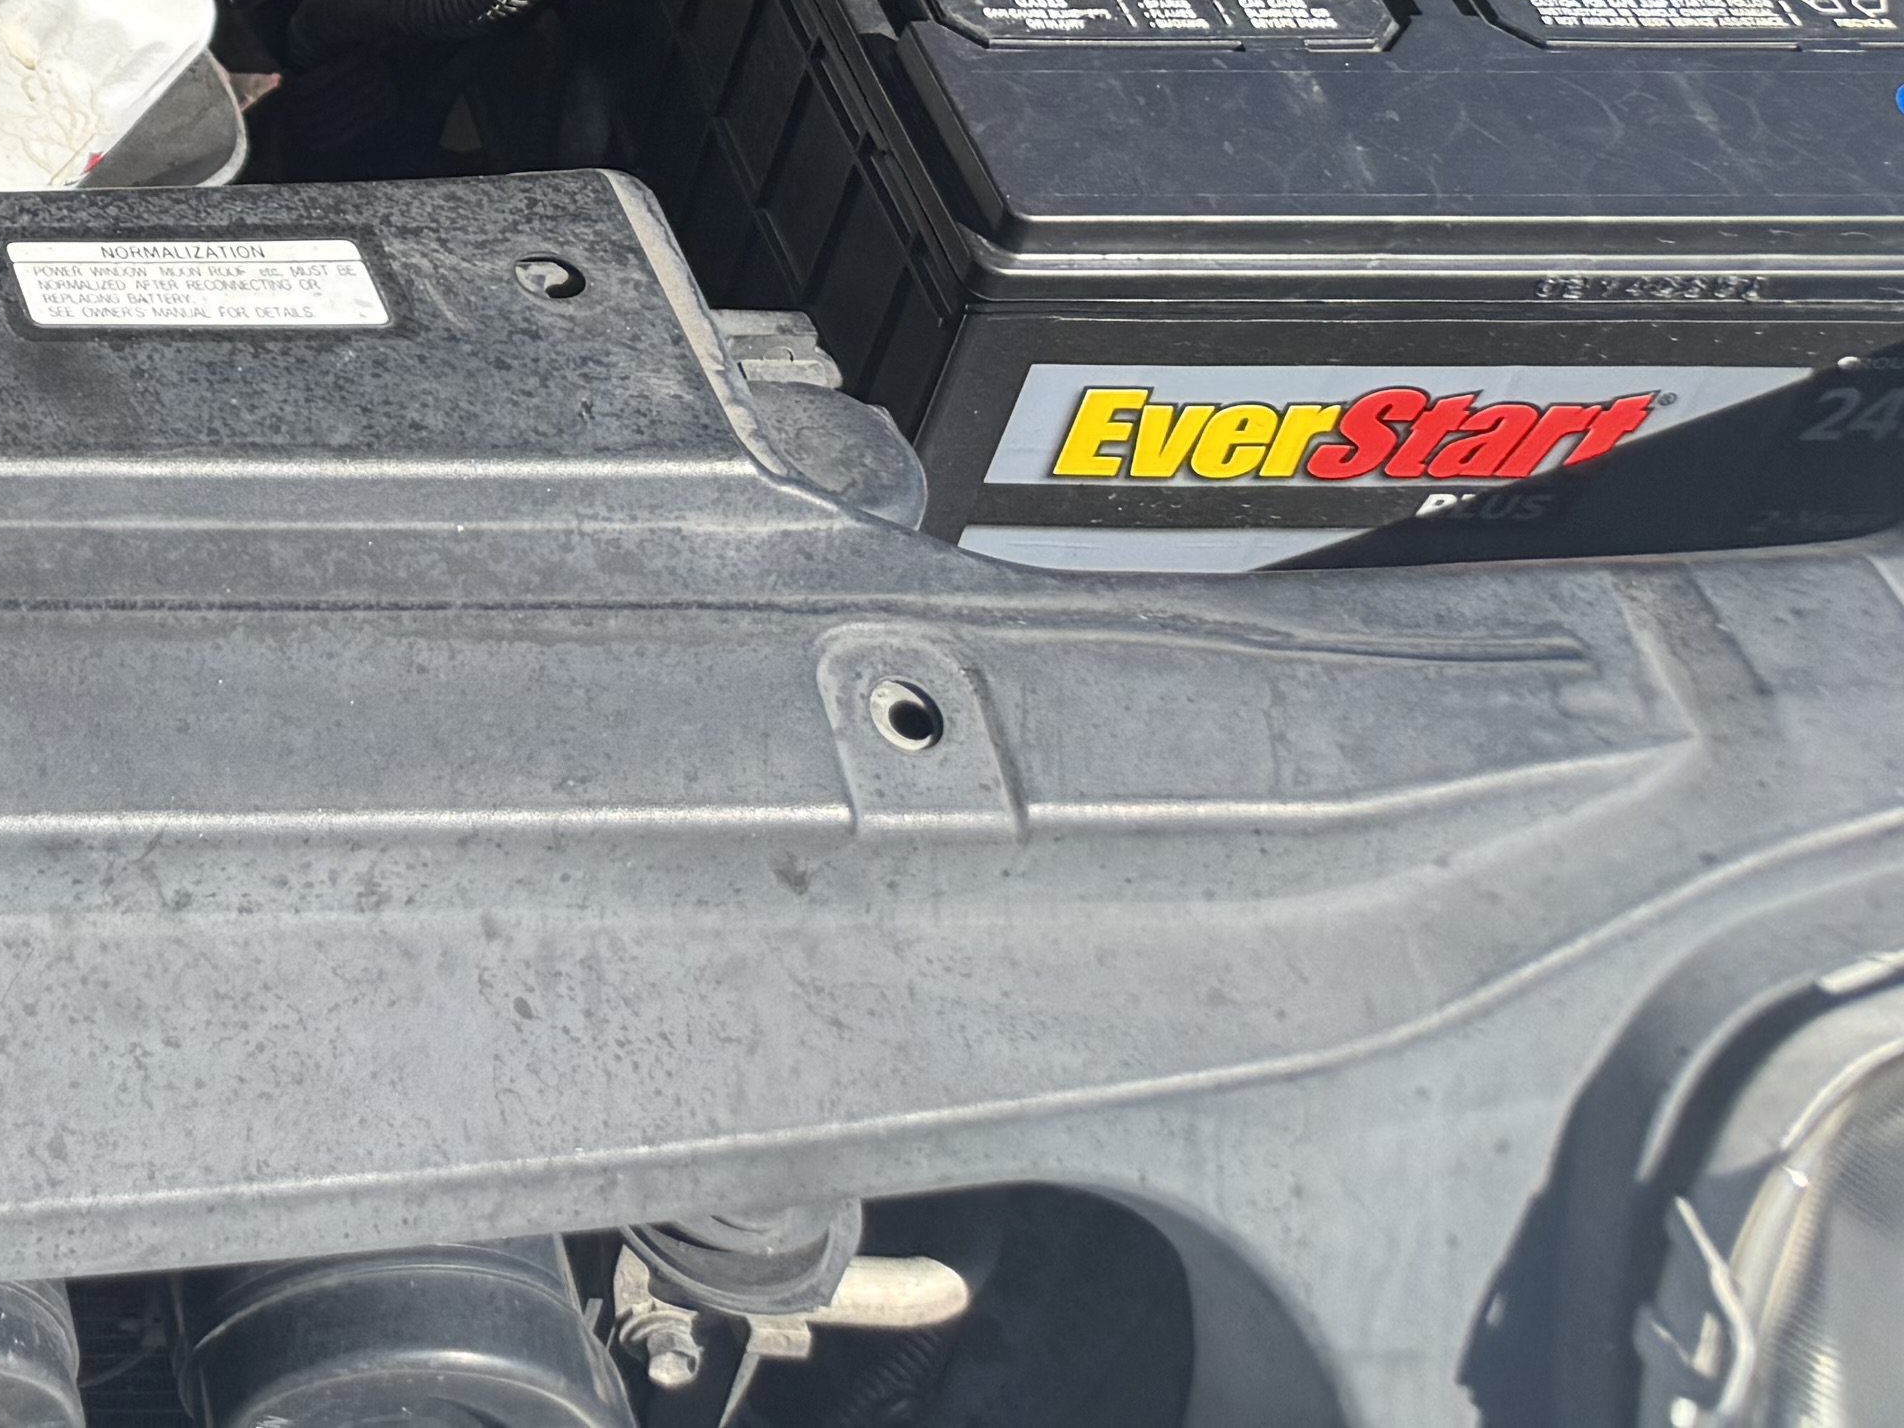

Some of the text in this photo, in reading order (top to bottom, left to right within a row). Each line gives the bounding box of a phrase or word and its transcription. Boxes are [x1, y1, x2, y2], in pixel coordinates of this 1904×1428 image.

[100, 245, 266, 260] NORMALIZATION
[32, 265, 83, 277] POWER
[89, 265, 147, 277] WINDOW
[289, 264, 328, 277] MUST
[336, 264, 357, 276] BE
[37, 278, 321, 291] NORMALIZED AFTER RECONNECTING OR
[42, 292, 121, 304] REPLACING
[48, 306, 75, 317] SEE
[152, 306, 211, 318] MANUAL
[218, 306, 250, 318] FOR
[1797, 387, 1904, 441] 24
[1053, 387, 1662, 480] EverStart
[1414, 493, 1553, 521] PLUS
